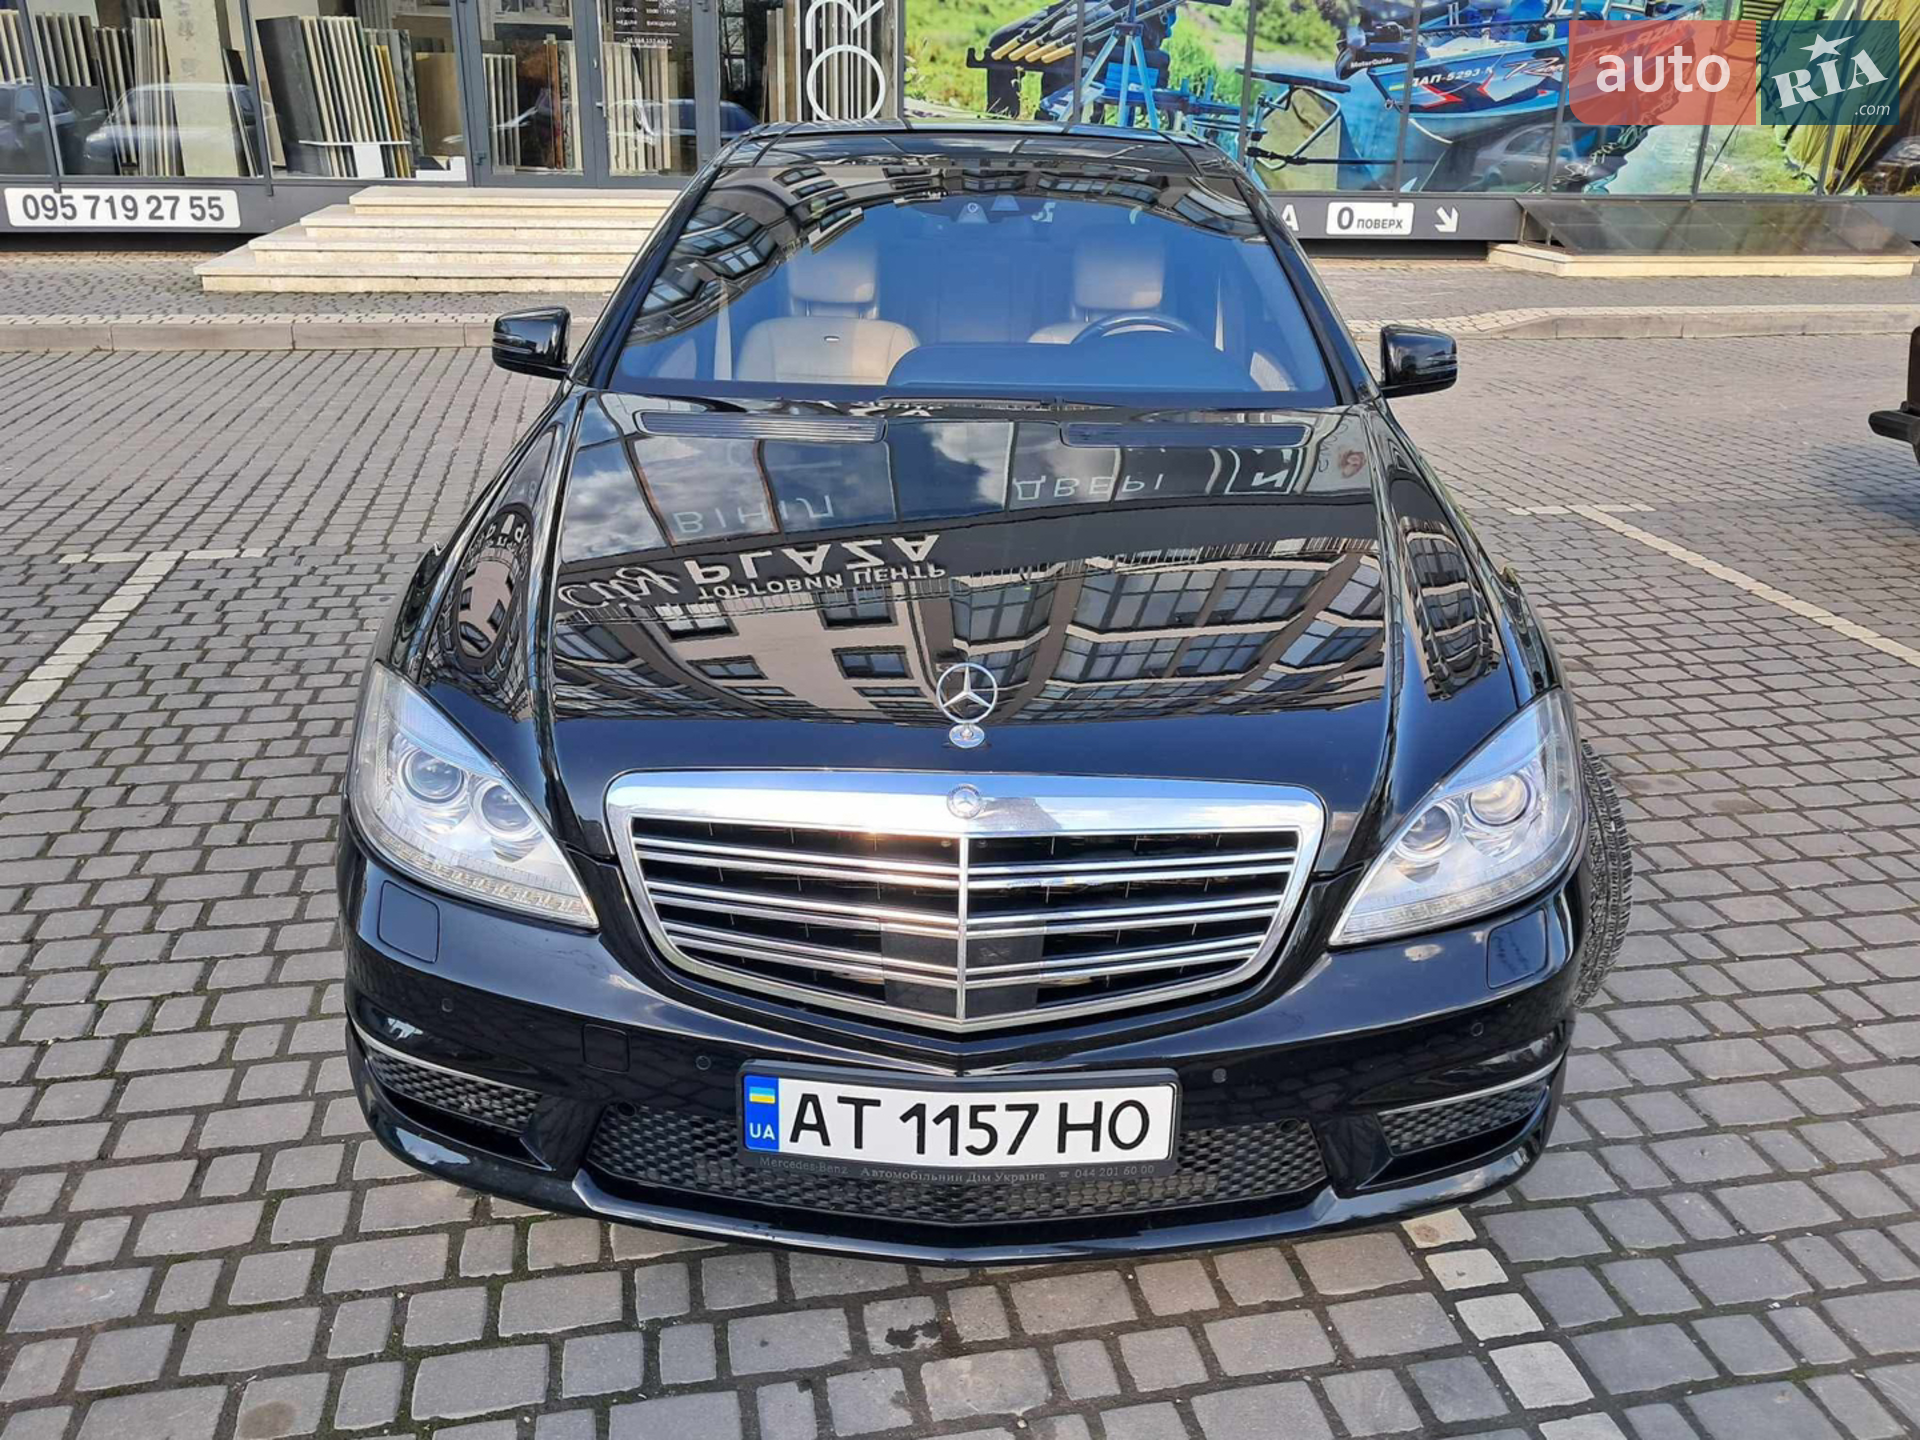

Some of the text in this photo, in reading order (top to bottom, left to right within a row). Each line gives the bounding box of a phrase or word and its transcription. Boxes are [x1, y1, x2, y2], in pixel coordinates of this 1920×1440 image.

[1350, 57, 1394, 69] MotorGuide
[22, 194, 225, 222] 095 719 27 55
[1356, 218, 1403, 230] ПОВЕРХ
[749, 1121, 776, 1141] UA
[789, 1093, 1151, 1157] AT 1157 HO
[759, 1157, 849, 1175] Mercedes-Benz
[1074, 1168, 1096, 1179] 044
[1100, 1166, 1119, 1178] 201
[1140, 1164, 1155, 1175] 00
